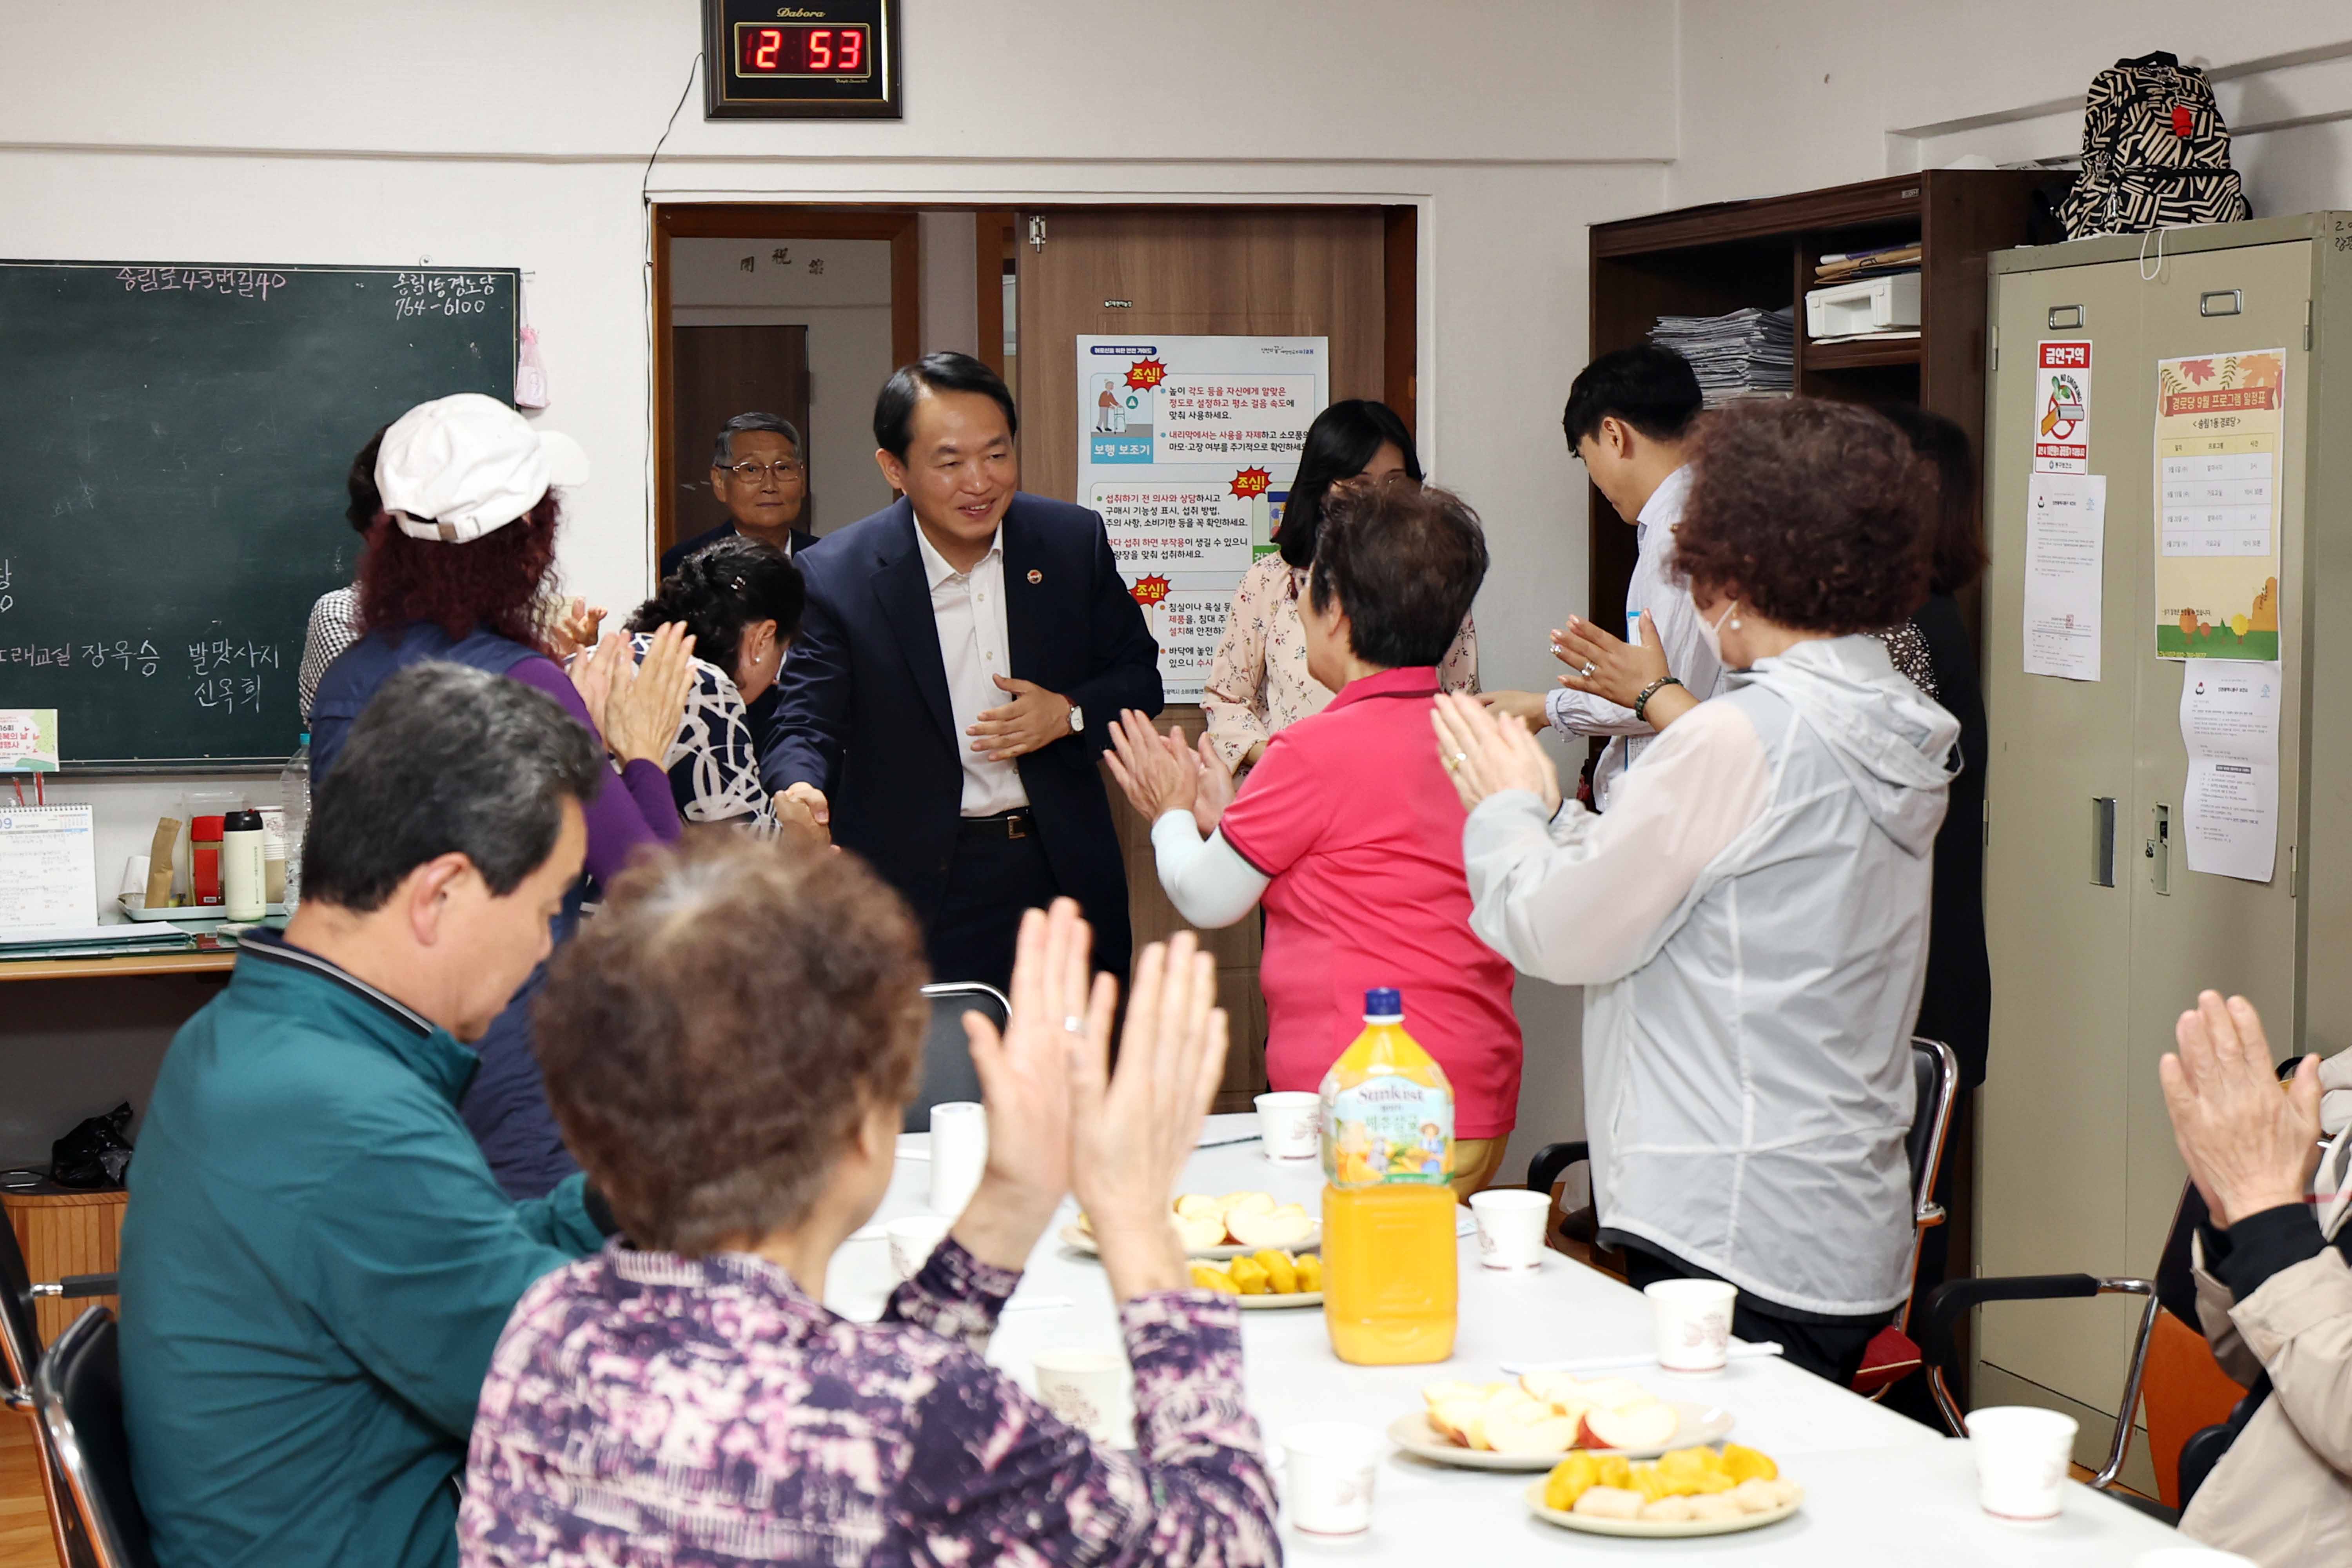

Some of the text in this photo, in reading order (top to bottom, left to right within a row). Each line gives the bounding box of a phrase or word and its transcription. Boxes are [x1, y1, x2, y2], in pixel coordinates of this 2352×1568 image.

[777, 7, 826, 18] Dabora
[2045, 347, 2085, 365] 금연구역
[1132, 367, 1160, 383] 조심!
[2060, 374, 2067, 382] NO
[1169, 386, 1286, 396] 높이 각도 등을 자신에게 알맞은
[1169, 398, 1295, 408] 정도로 설정하고 평소 걸음 속도에
[2172, 391, 2266, 411] 경로당 9월 프로그램 일정표
[1169, 410, 1232, 420] 맞춰 사용하세요.
[1169, 430, 1217, 440] 내리막에서는
[1219, 430, 1243, 440] 사용을
[1245, 430, 1277, 440] 자제하고
[1094, 444, 1150, 457] 보행 보조기
[1205, 443, 1228, 452] 여부를
[1230, 443, 1268, 452] 주기적으로
[1237, 475, 1265, 491] 조심!
[1105, 494, 1221, 503] 섭취하기 전 의사와 상담하시고
[1105, 506, 1131, 515] 구매시
[1133, 506, 1158, 515] 기능성
[1182, 506, 1199, 515] 섭취
[1106, 519, 1121, 528] 주의
[1144, 519, 1176, 528] 소비기한
[1178, 519, 1194, 528] 등을
[1196, 519, 1204, 528] 꼭
[1206, 519, 1248, 528] 확인하세요.
[1124, 538, 1140, 547] 섭취
[1142, 538, 1158, 547] 하면
[1160, 538, 1193, 547] 부작용이
[1195, 538, 1211, 547] 생길
[1213, 538, 1221, 547] 수
[1223, 538, 1248, 547] 있으니
[1141, 550, 1158, 560] 맞춰
[1160, 550, 1204, 560] 섭취하세요.
[1136, 583, 1164, 598] 조심!
[1168, 603, 1202, 612] 침실이나
[1205, 603, 1221, 612] 욕실
[1168, 615, 1196, 624] 제품을,
[1199, 615, 1215, 624] 침대
[1169, 627, 1194, 637] 설치해
[1169, 646, 1213, 656] 바닥에 놓인
[188, 637, 279, 677] 발맛사지
[1168, 659, 1194, 669] 있으니
[1357, 1084, 1426, 1104] Sunkist
